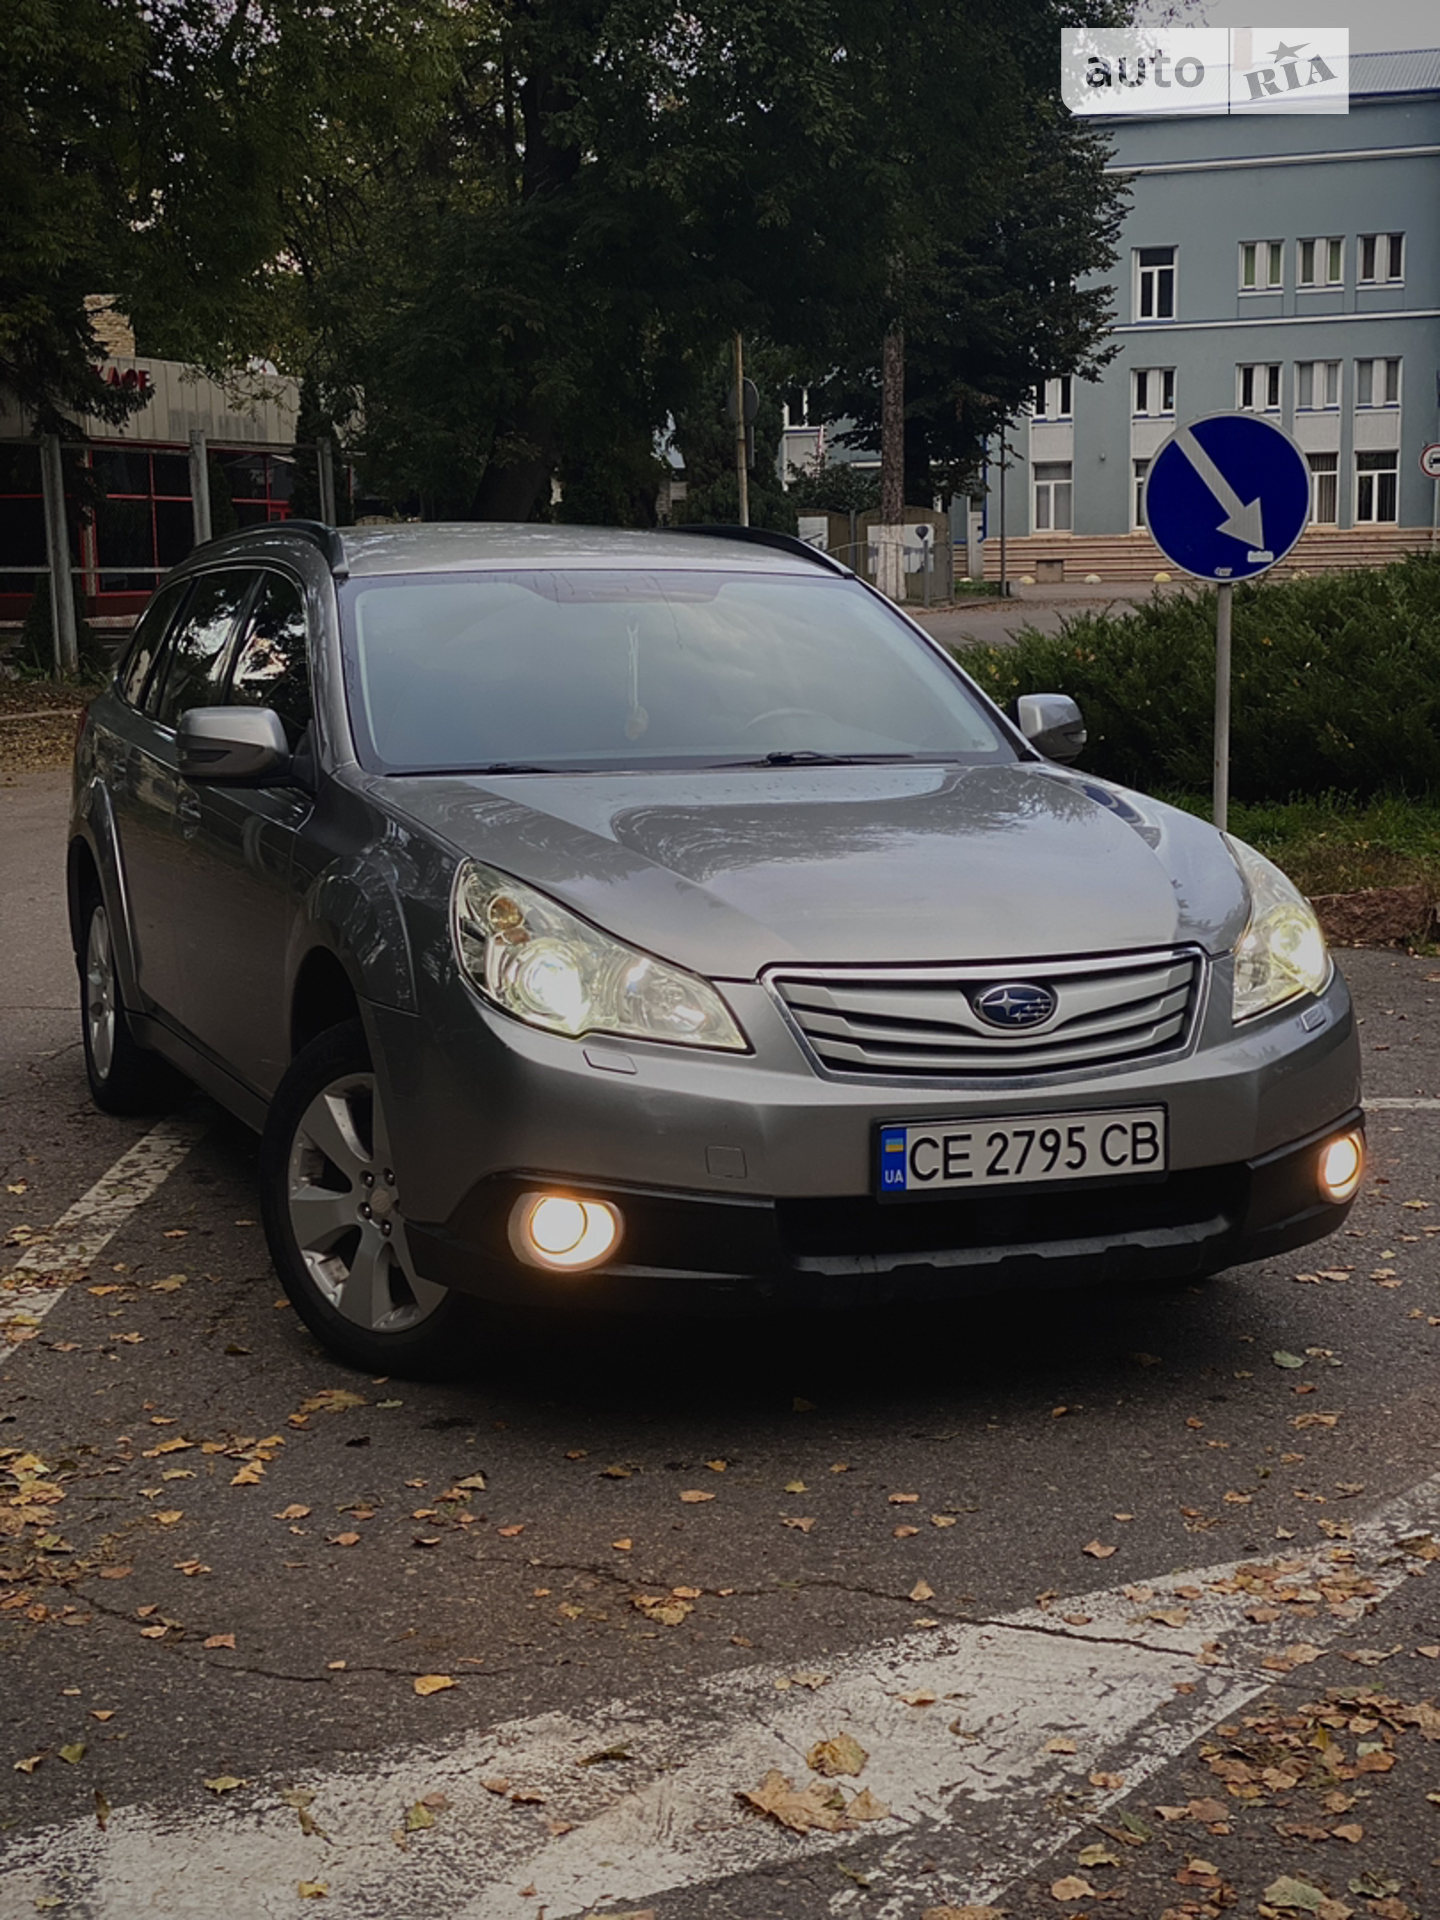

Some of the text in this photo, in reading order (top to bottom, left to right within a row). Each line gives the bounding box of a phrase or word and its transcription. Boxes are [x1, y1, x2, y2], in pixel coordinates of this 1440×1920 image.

[909, 1120, 1160, 1182] CE 2795 CB
[884, 1168, 904, 1184] UA
